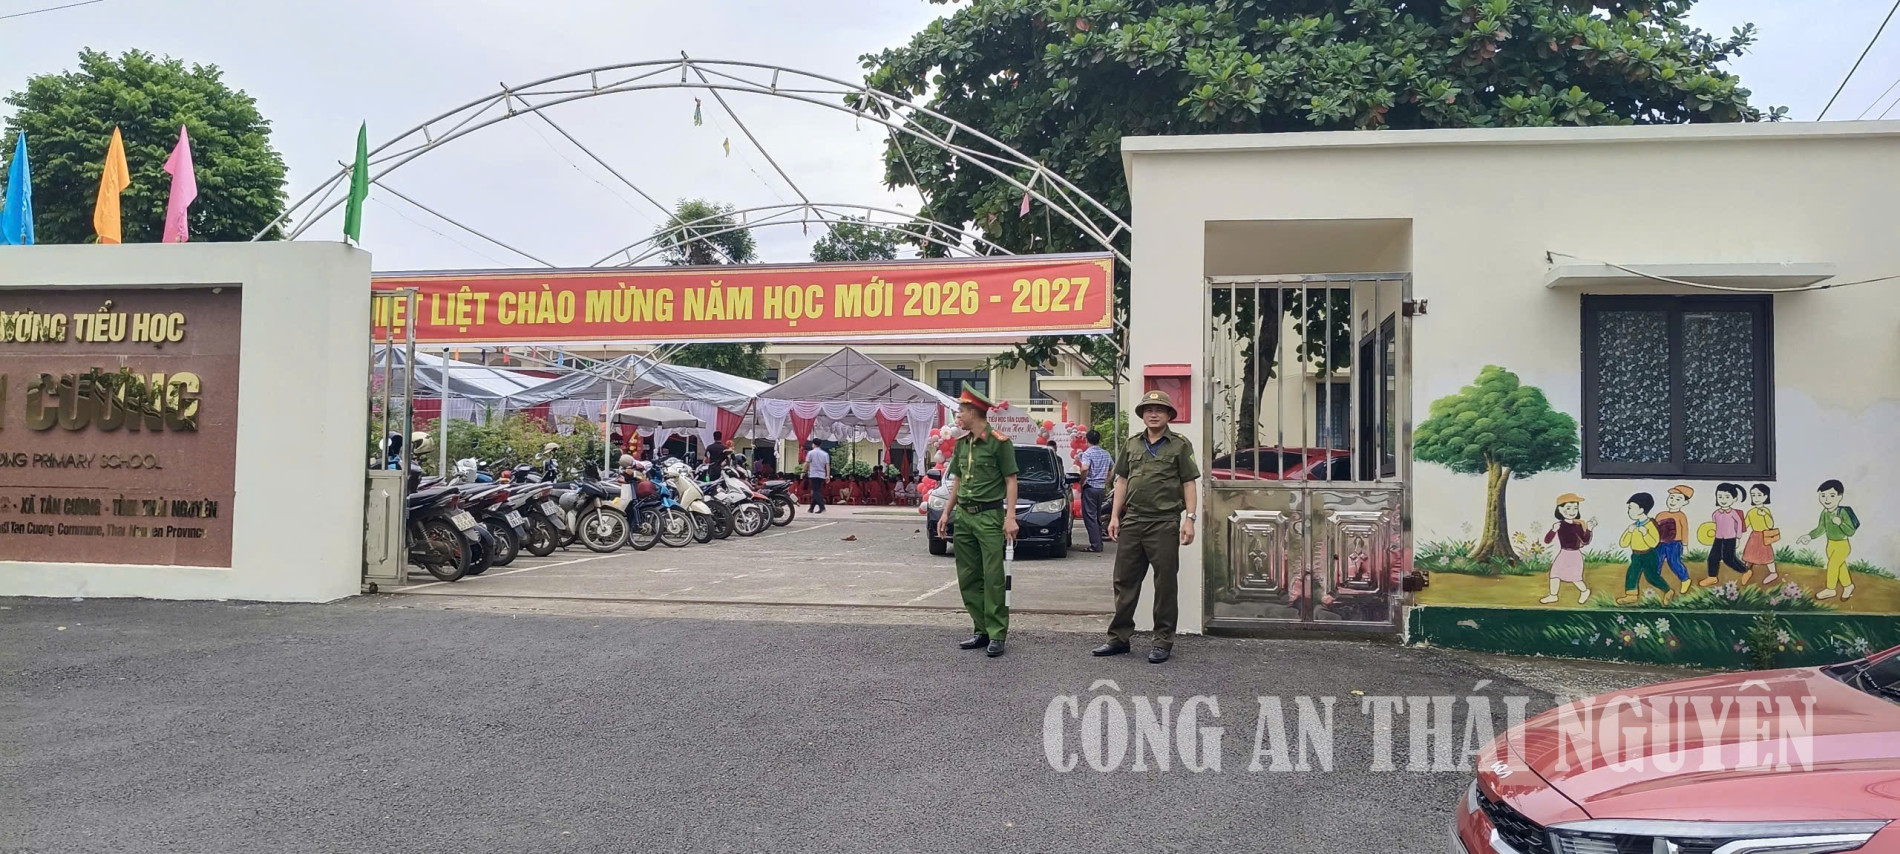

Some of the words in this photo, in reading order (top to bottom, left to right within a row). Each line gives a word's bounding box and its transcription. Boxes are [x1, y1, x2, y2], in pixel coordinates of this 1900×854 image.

[430, 285, 490, 333] LIỆT
[497, 283, 576, 325] CHÀO
[585, 281, 674, 323] MỪNG
[683, 279, 754, 321] NĂM
[763, 284, 824, 327] HỌC
[834, 275, 894, 318] MỚI
[903, 280, 979, 317] 2026
[1011, 276, 1091, 313] 2027
[74, 300, 127, 342] TIỂU
[132, 312, 185, 349] HỌC
[33, 453, 94, 469] PRIMARY
[100, 453, 163, 470] SCHOOL
[11, 522, 25, 534] Tan
[27, 522, 55, 536] Cuong
